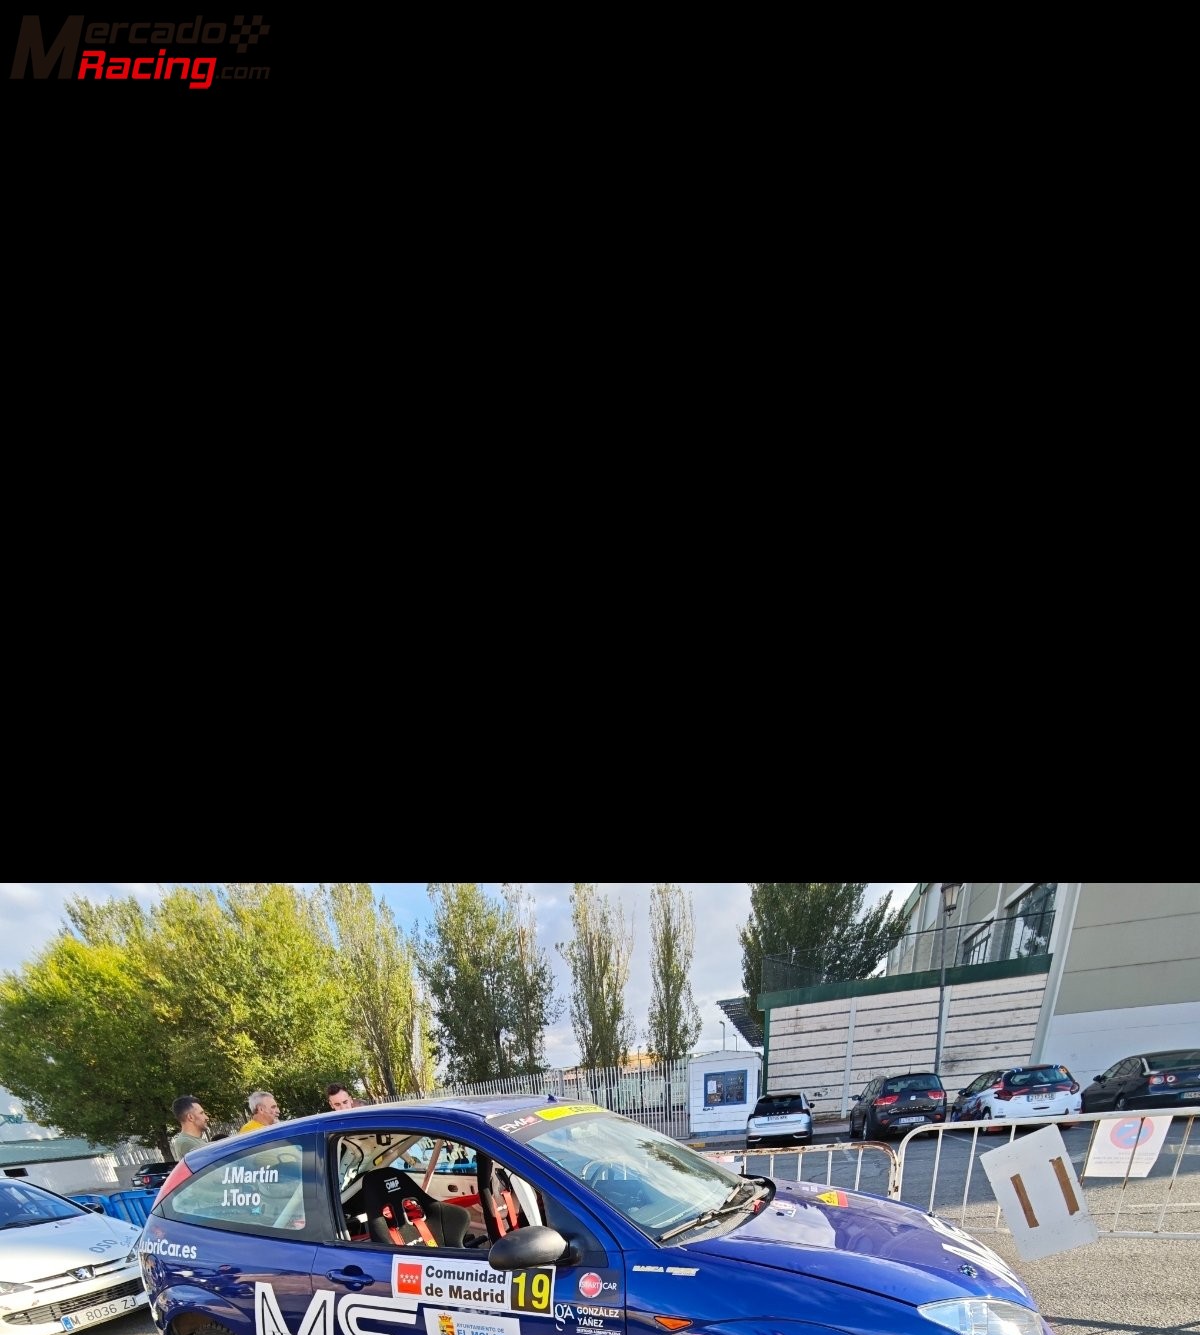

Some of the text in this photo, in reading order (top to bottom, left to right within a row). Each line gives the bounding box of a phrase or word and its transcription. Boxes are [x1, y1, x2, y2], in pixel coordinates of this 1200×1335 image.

[222, 1164, 279, 1184] J.Martín
[385, 1179, 400, 1190] OMP
[221, 1188, 261, 1207] J.Toro
[425, 1264, 507, 1285] Comunidad
[425, 1283, 505, 1304] de Madrid
[512, 1272, 550, 1310] 19
[602, 1281, 618, 1291] CAR
[73, 1296, 138, 1326] M 8036 ZJ
[576, 1306, 620, 1318] GONZÁLEZ
[456, 1322, 496, 1333] AYUNTAMIENTO
[577, 1316, 604, 1328] YÁÑEZ
